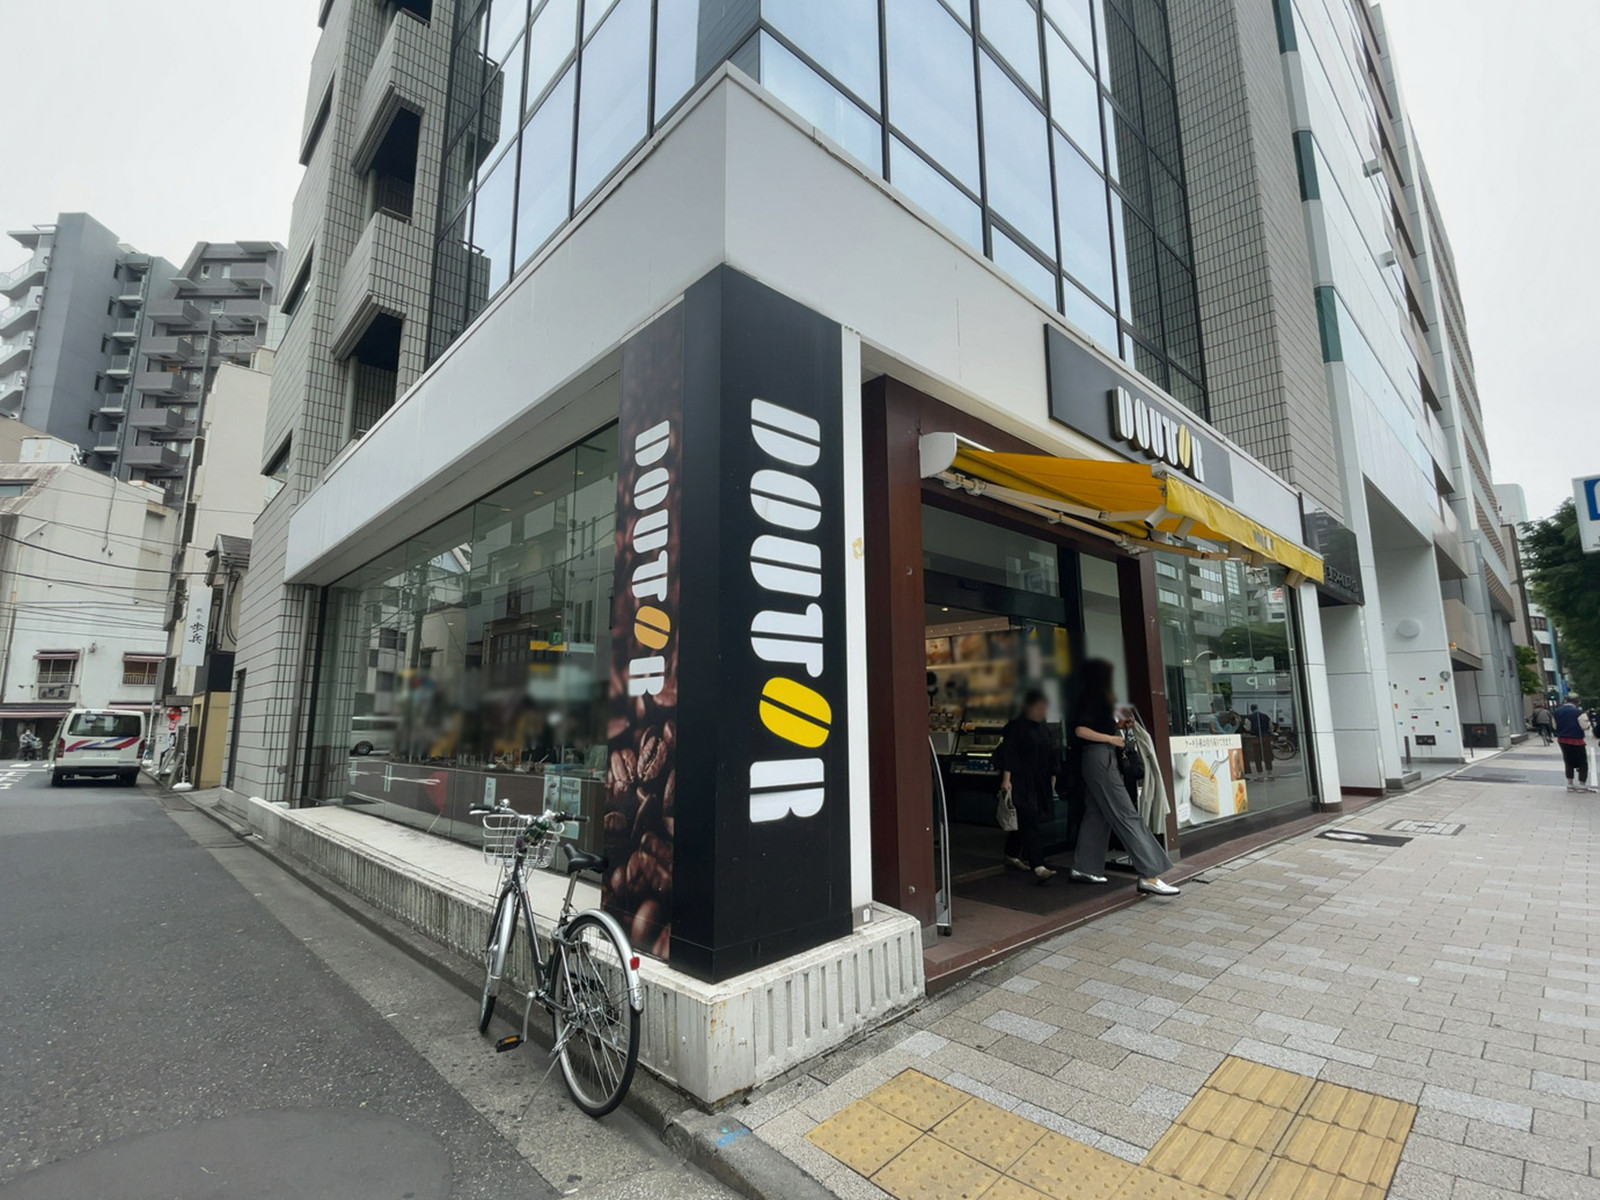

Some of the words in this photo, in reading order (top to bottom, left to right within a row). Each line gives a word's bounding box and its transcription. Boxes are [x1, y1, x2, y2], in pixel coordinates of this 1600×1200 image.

[627, 419, 671, 698] DOUTOR
[1117, 385, 1205, 483] DOUTOR
[749, 398, 832, 823] DOUTOR
